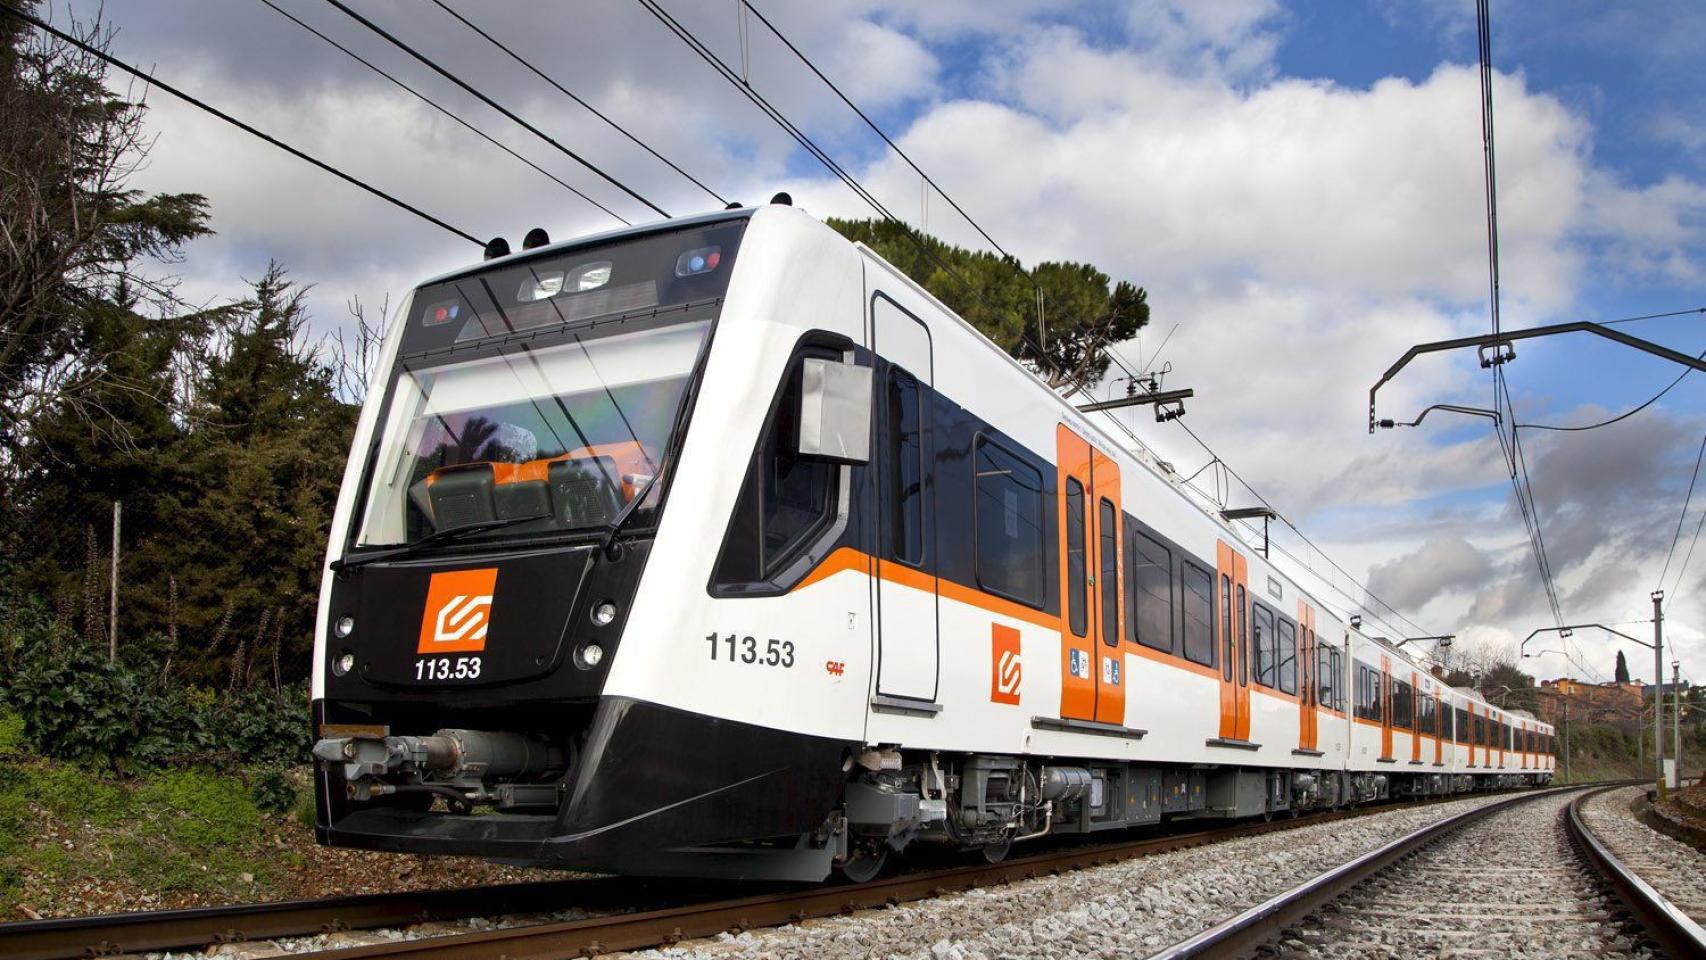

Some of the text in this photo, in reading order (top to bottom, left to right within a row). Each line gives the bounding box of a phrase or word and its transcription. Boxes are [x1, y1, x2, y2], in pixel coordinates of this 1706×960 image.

[705, 632, 795, 668] 113.53
[415, 657, 482, 681] 113.53
[827, 661, 846, 676] CAF
